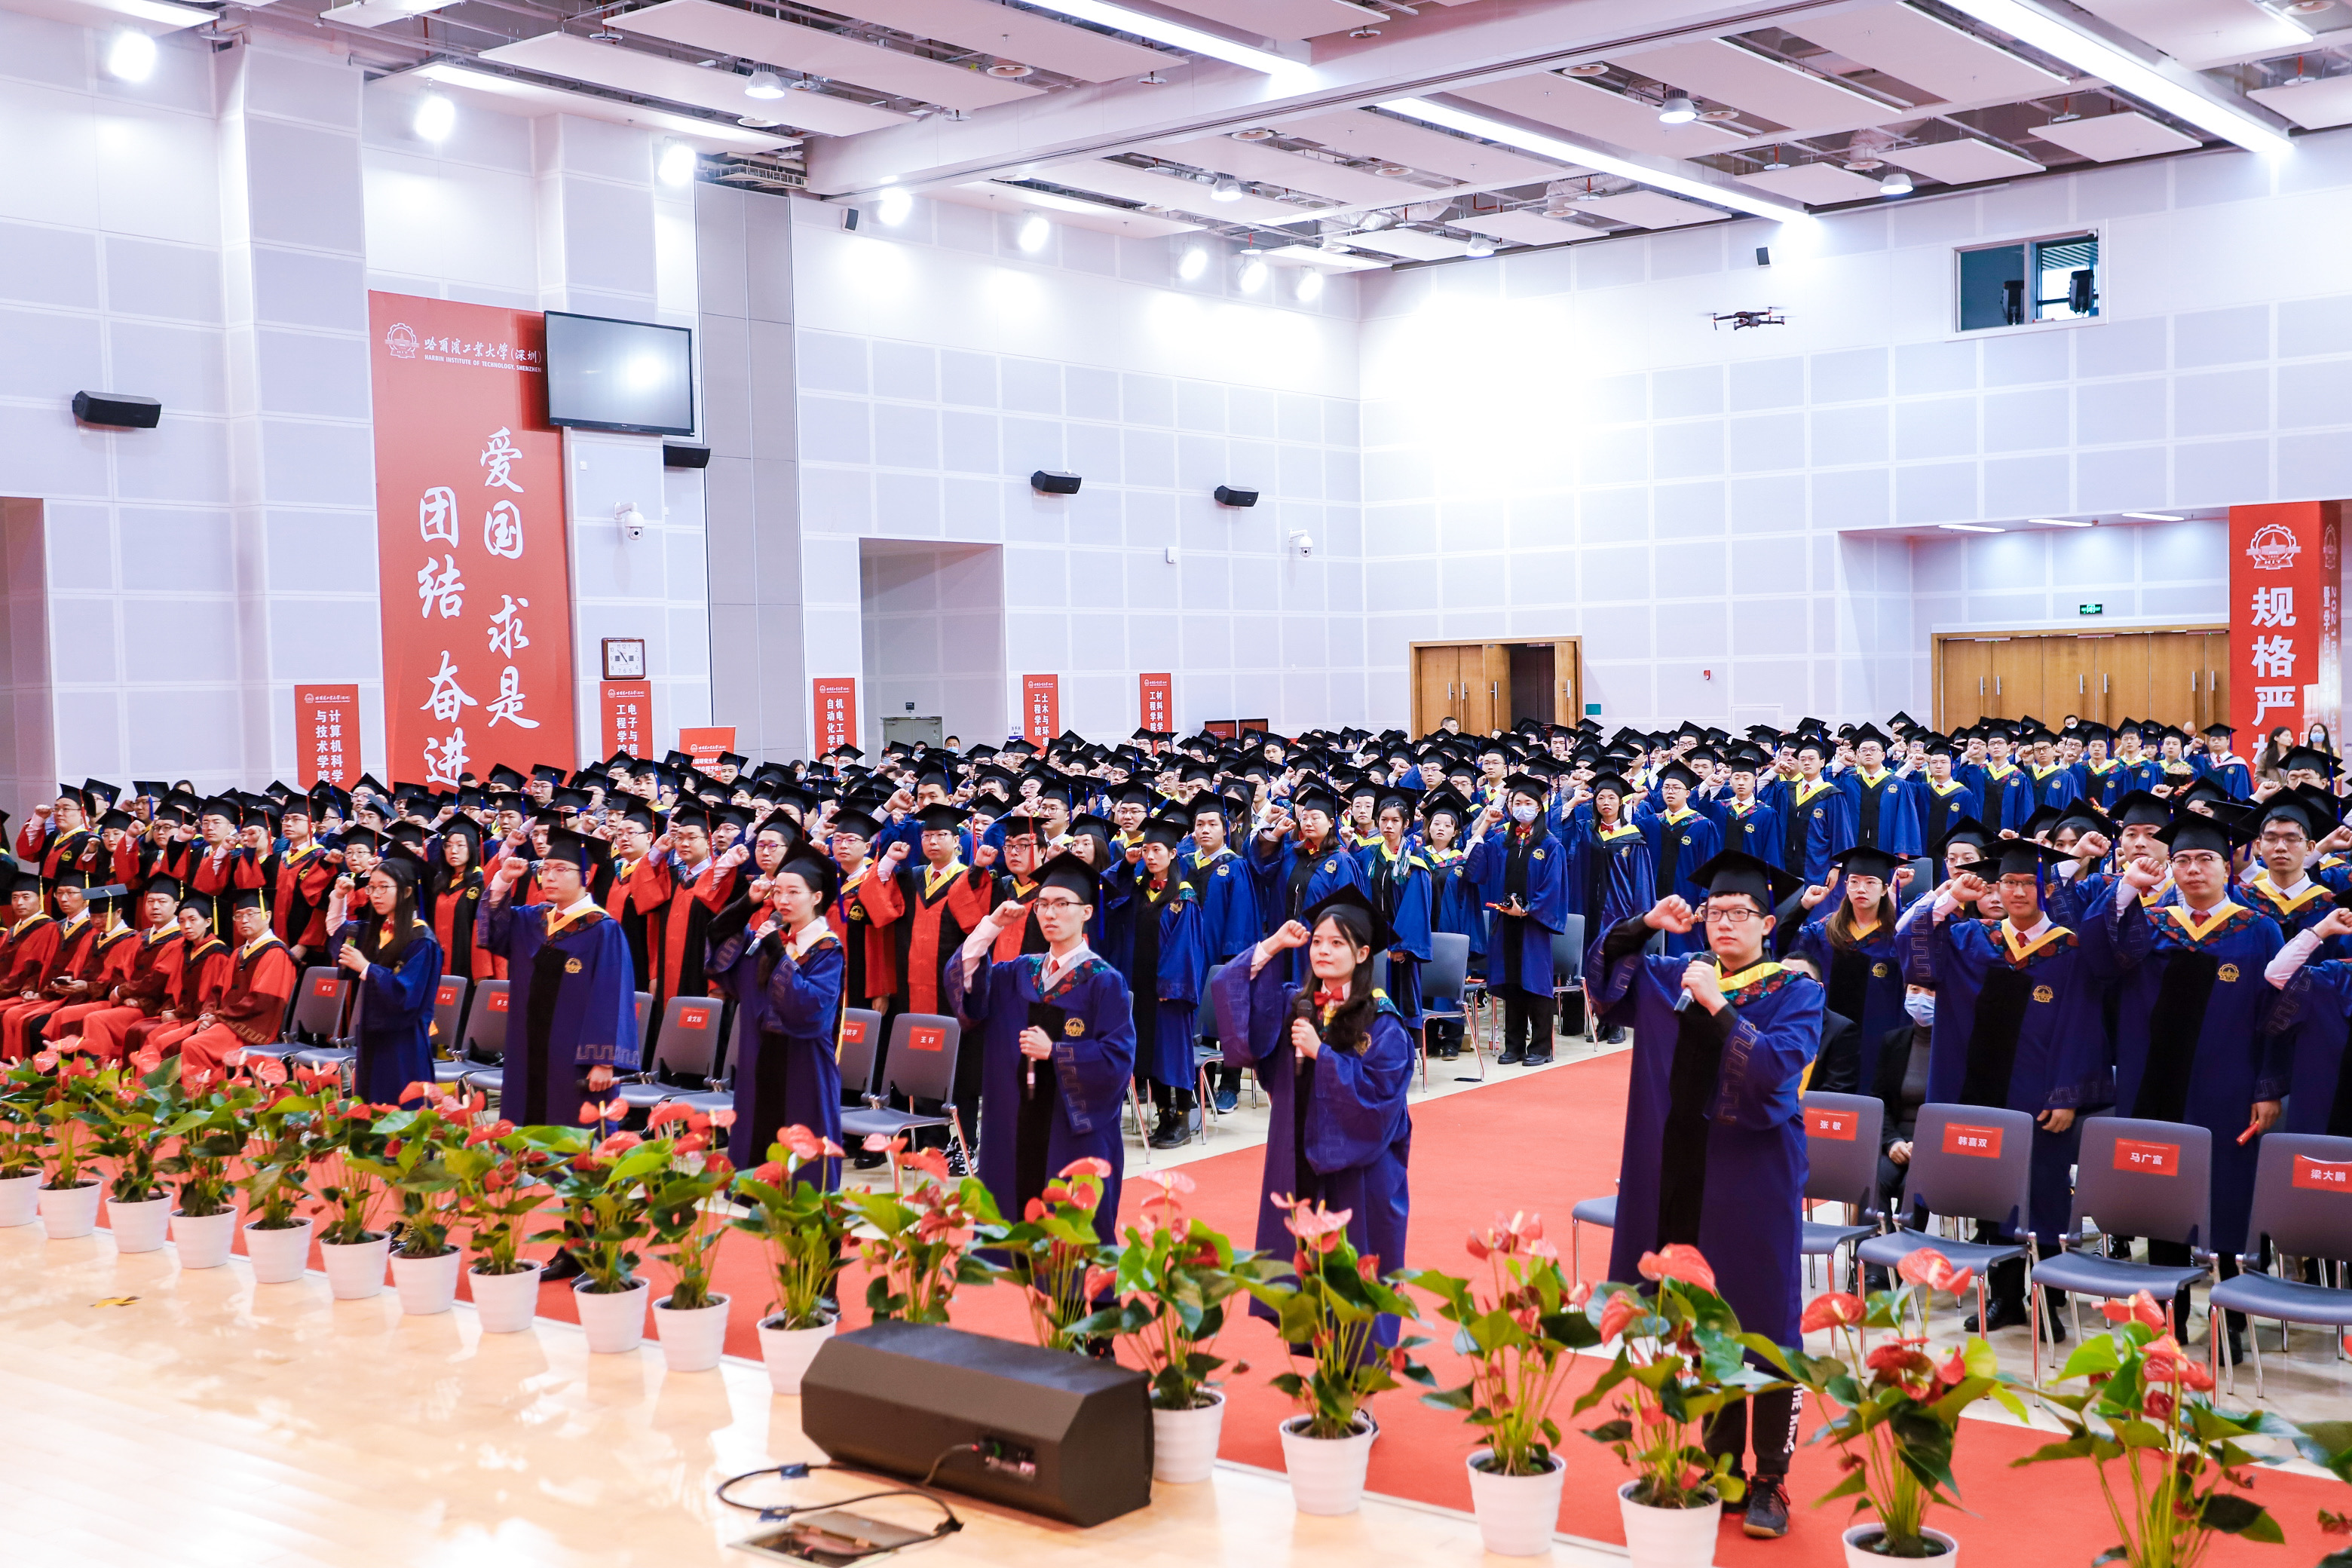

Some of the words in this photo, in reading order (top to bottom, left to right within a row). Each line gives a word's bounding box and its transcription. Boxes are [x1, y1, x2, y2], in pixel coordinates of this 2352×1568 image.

[446, 357, 471, 365] INSTITUTE
[479, 426, 525, 559] 爱国
[417, 486, 466, 620] 团结
[485, 594, 541, 730] 求是
[419, 650, 478, 789] 奋进
[628, 703, 639, 761] 电子与信
[835, 699, 844, 747] 机电工程
[1034, 694, 1042, 737] 工程学院
[1041, 693, 1049, 747] 土木与环境
[1149, 691, 1157, 732] 工程学院
[1156, 691, 1164, 732] 材料科学
[315, 710, 330, 782] 与技术学院
[329, 709, 344, 782] 计算机科学
[1958, 1136, 1988, 1148] 韩喜双
[2130, 1152, 2163, 1165] 马广富
[2310, 1169, 2346, 1182] 梁大鹏
